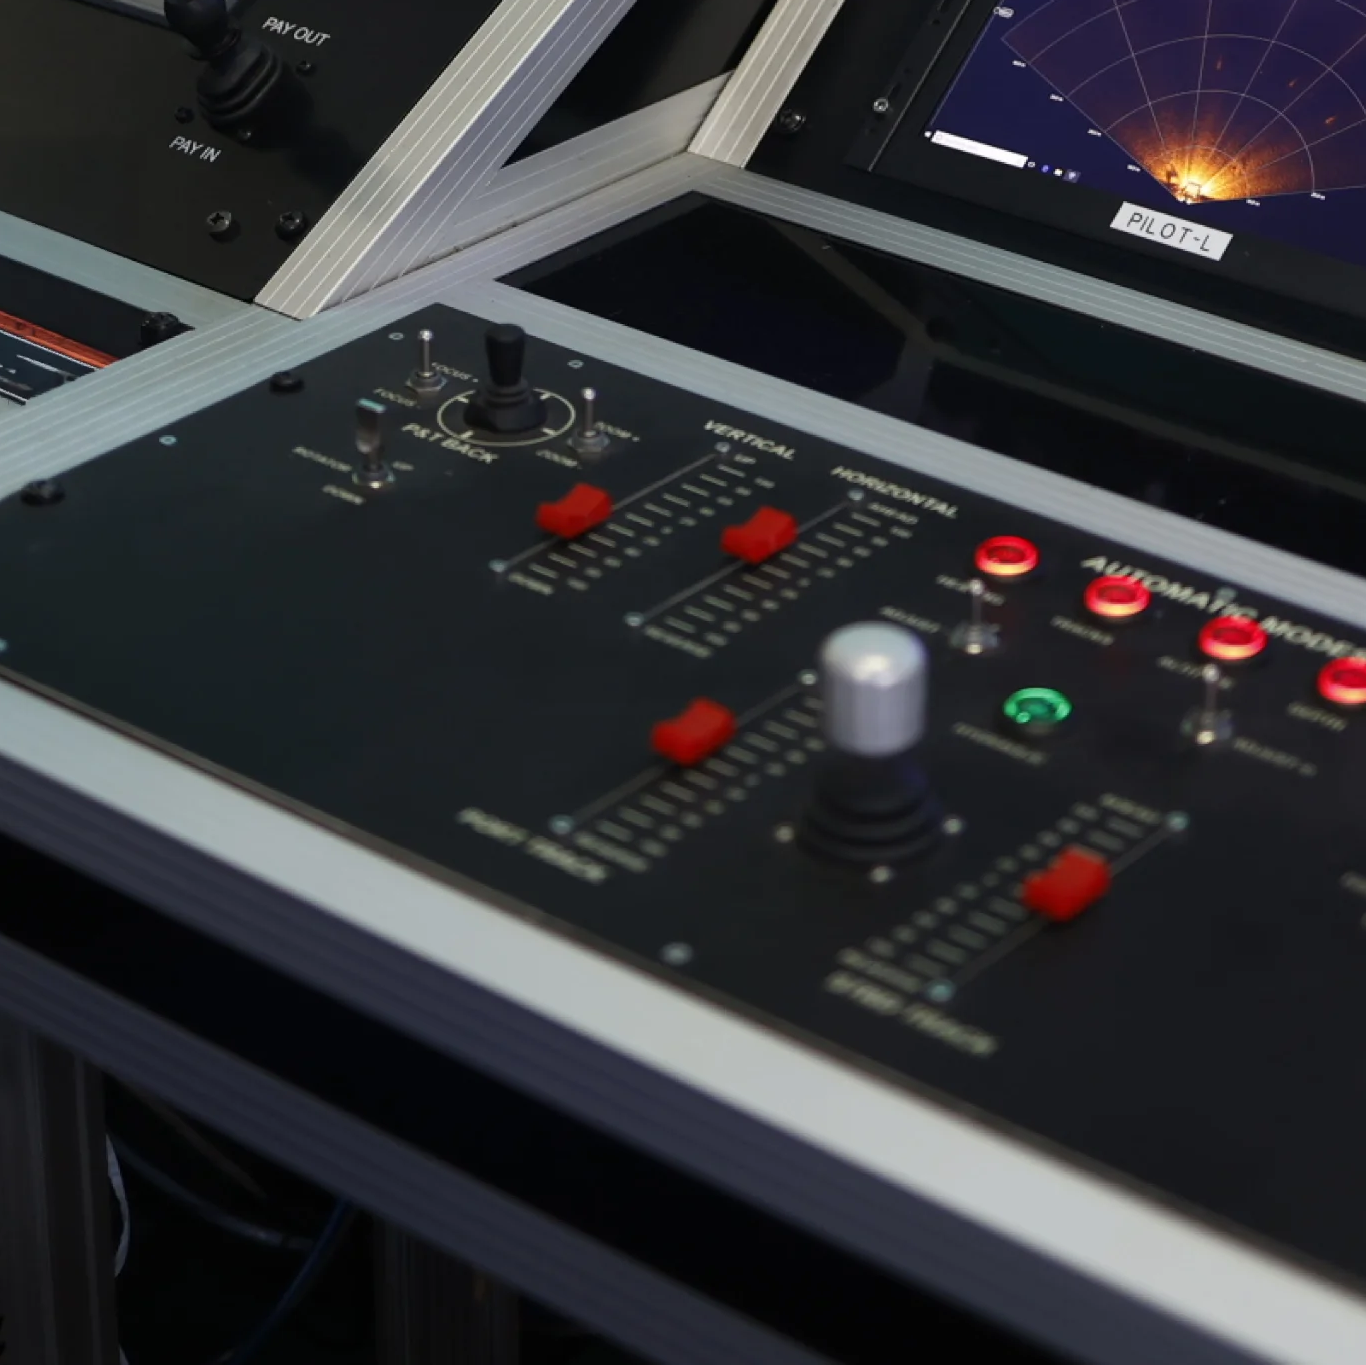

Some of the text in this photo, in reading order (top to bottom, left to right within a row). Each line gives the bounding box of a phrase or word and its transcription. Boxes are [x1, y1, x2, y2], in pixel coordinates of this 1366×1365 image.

[262, 16, 331, 47] PAY OUT
[169, 136, 222, 163] PAY IN
[1126, 212, 1211, 253] PILOT-L
[401, 422, 499, 464] P&T BACK
[703, 419, 795, 461] VERTICAL
[831, 466, 958, 519] HORIZONTAL
[1082, 554, 1259, 620] AUTOMATIC
